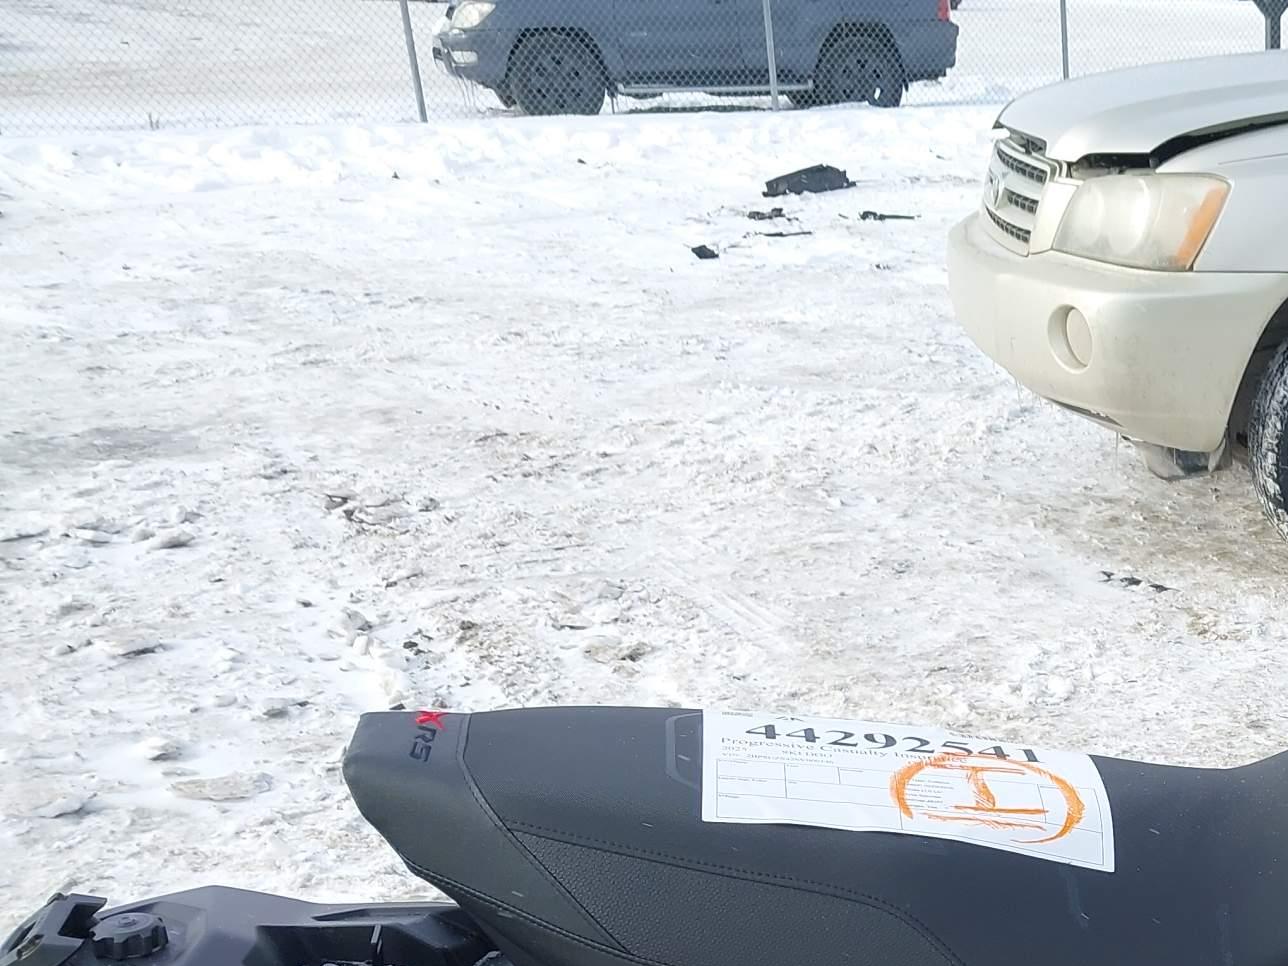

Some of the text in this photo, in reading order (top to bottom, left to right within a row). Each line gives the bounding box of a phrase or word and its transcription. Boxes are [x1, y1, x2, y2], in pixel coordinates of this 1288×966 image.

[721, 737, 815, 752] Progressive
[819, 745, 888, 758] Casualty
[745, 724, 1044, 763] 44292541
